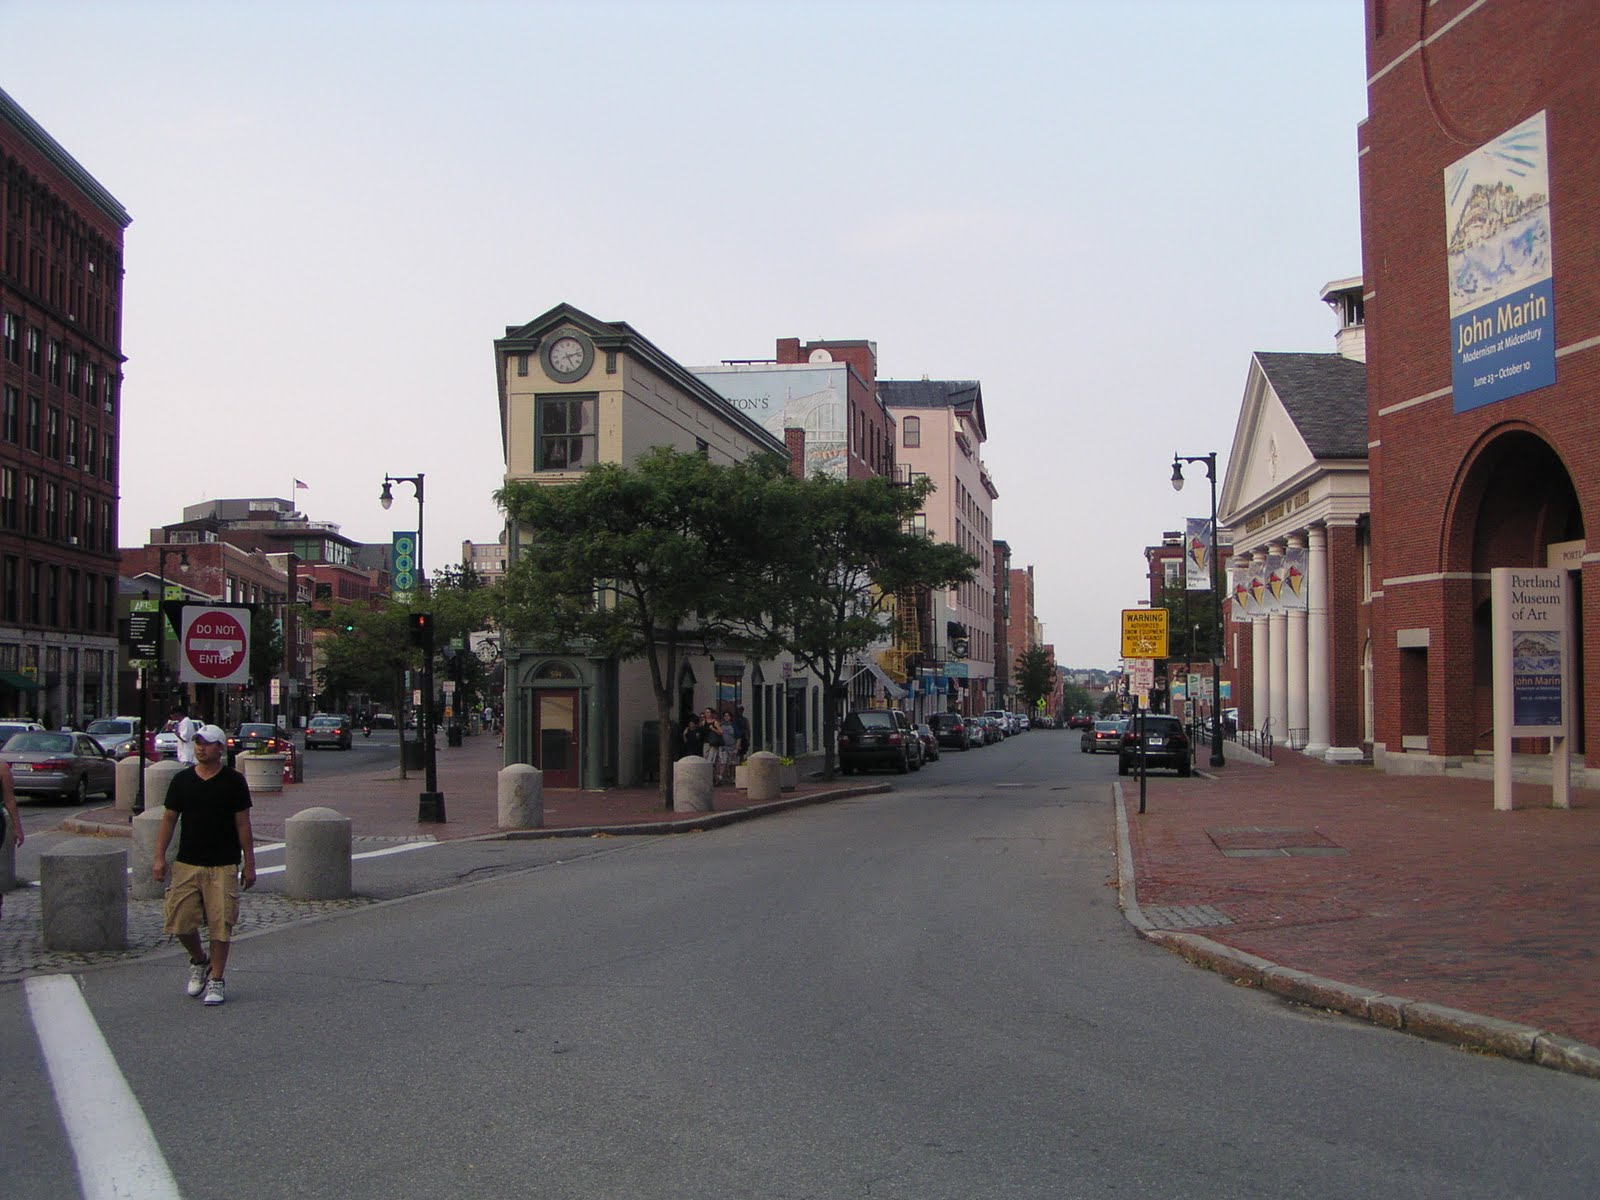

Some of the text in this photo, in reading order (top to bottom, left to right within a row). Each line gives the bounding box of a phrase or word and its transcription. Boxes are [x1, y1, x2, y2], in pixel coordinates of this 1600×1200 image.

[1458, 293, 1546, 353] John Marin
[1462, 328, 1542, 364] Modernism at Midcentury
[1473, 376, 1487, 388] June
[1487, 373, 1494, 384] 23
[1499, 364, 1522, 379] October
[1523, 361, 1531, 371] 10
[1512, 574, 1560, 588] Portland
[1512, 591, 1560, 604] Museum
[1512, 607, 1546, 620] of Art
[196, 624, 236, 635] DO NOT
[1514, 676, 1560, 687] John Marin
